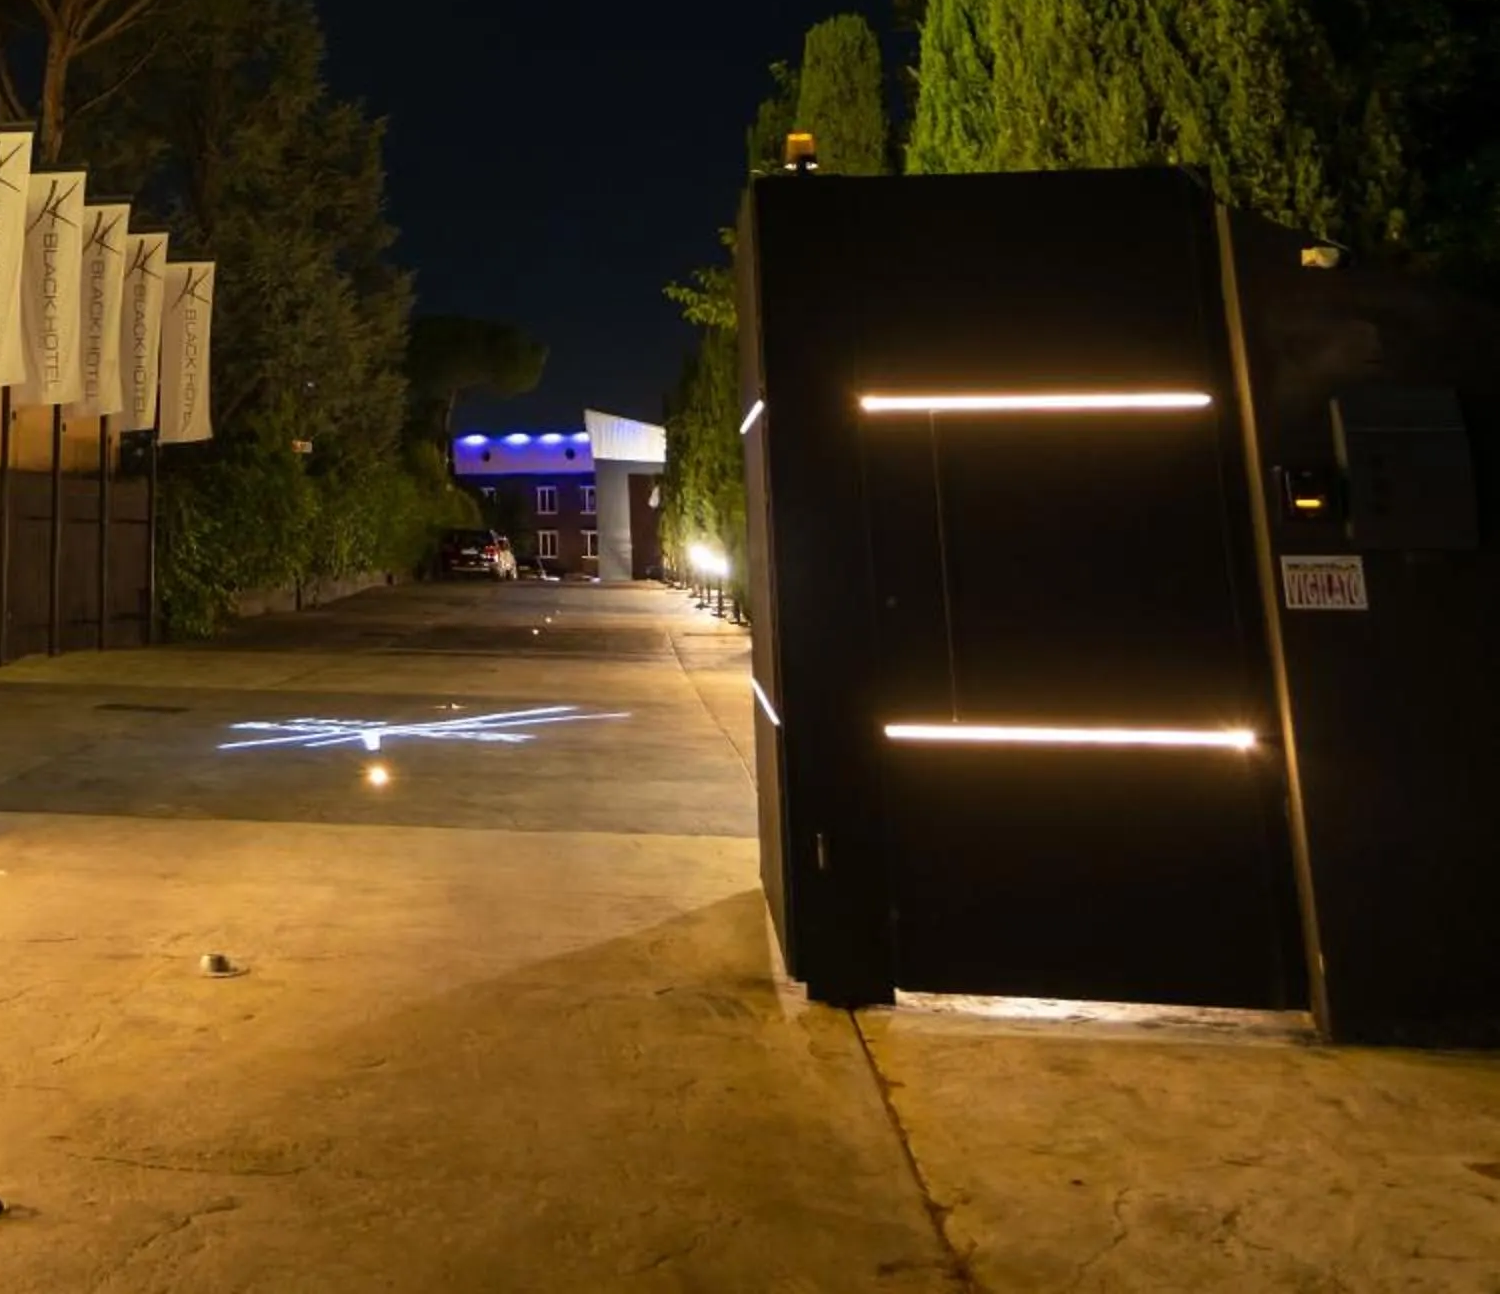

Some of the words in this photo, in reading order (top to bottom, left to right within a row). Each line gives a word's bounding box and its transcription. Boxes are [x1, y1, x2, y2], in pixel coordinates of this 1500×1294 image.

[42, 233, 60, 310] BLACK
[90, 260, 105, 333] BLACK
[133, 283, 147, 352] BLACK
[184, 309, 198, 369] BLACK
[43, 315, 62, 391] HOTEL
[85, 335, 102, 403] HOTEL
[133, 355, 148, 420] HOTEL
